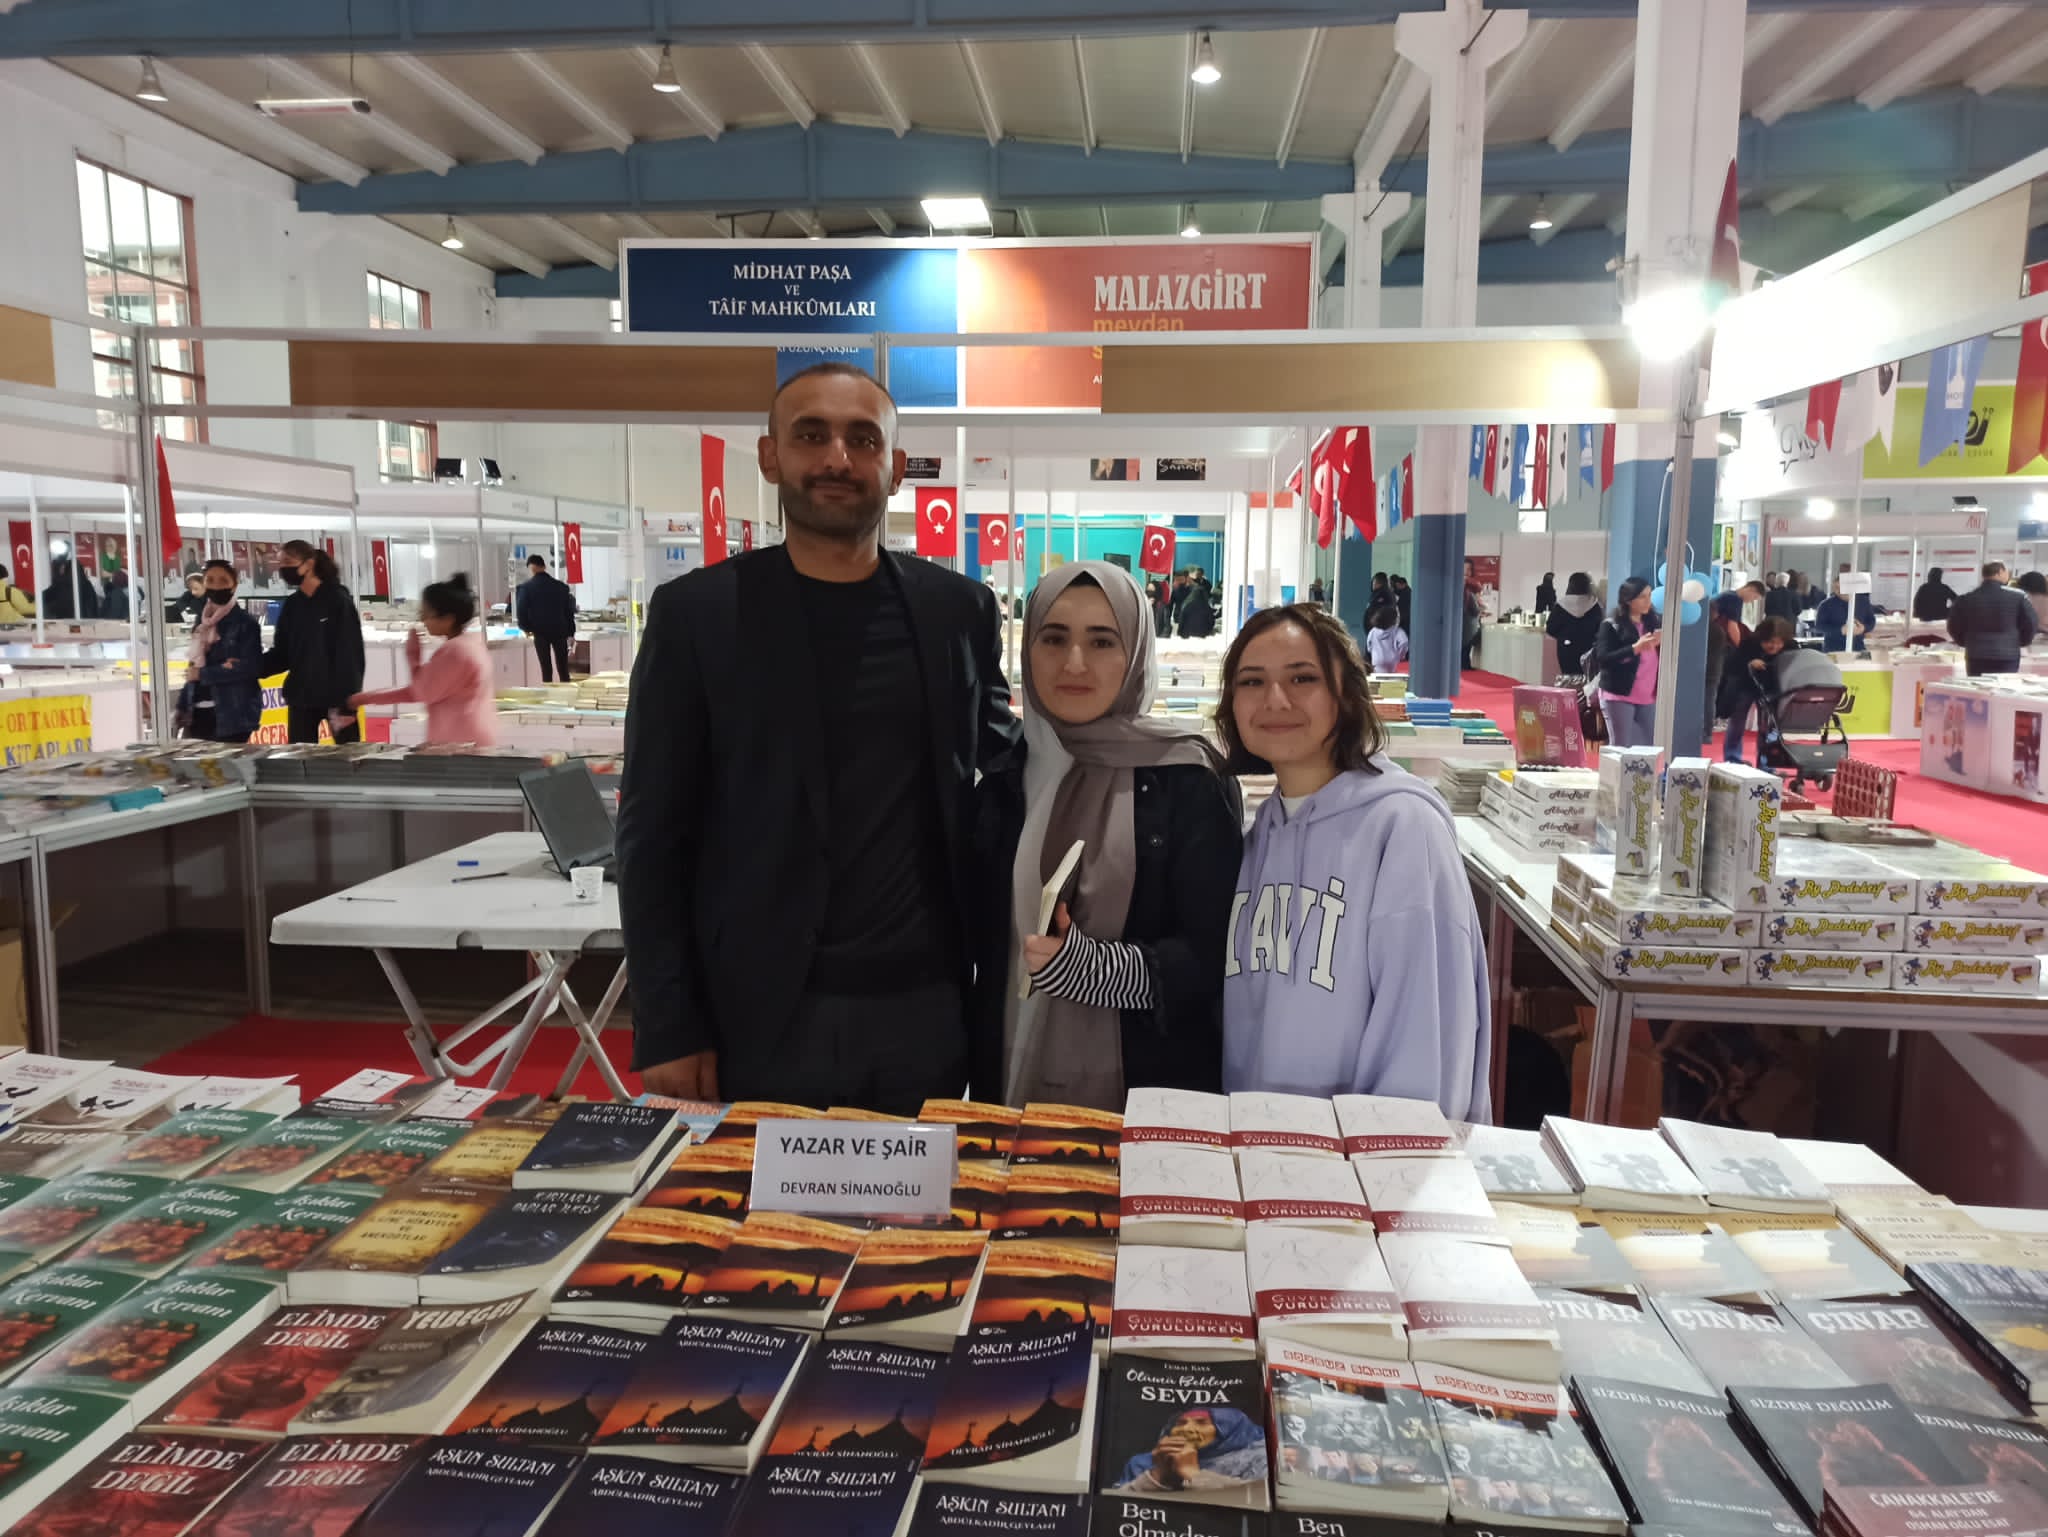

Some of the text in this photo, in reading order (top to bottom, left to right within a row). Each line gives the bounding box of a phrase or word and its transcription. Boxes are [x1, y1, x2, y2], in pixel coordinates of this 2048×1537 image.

[733, 262, 852, 283] MİDHAT PAŞA
[784, 285, 800, 296] VE
[1094, 268, 1267, 312] MALAZGİRT
[708, 297, 876, 317] TÂİF MAHKÛMLARI
[6, 707, 91, 733] ORTAOKUL
[780, 1136, 928, 1161] YAZAR VE ŞAİR
[780, 1180, 922, 1197] DEVRAN SİNANOĞLU
[1273, 1299, 1391, 1312] VURULURKEN
[274, 1309, 387, 1331] ELİMDE
[1128, 1323, 1244, 1335] VURULURKEN
[1671, 1308, 1785, 1334] ÇINAR
[1807, 1308, 1929, 1334] ÇINAR
[263, 1328, 351, 1350] DEĞİL
[538, 1330, 648, 1353] AŞKIN SULTANI
[676, 1325, 786, 1349] AŞKIN SULTANI
[967, 1331, 1077, 1356] AŞKIN SULTANI
[827, 1348, 937, 1371] AŞKIN SULTANI
[1140, 1385, 1231, 1404] SEVDA
[1815, 1397, 1894, 1412] DEĞİLİM
[0, 1422, 71, 1443] ervanı
[1913, 1413, 1972, 1432] İZDEN
[111, 1440, 246, 1472] ELİMDE
[278, 1439, 410, 1464] ELİMDE
[429, 1448, 556, 1477] AŞKIN SULTANI
[91, 1465, 202, 1497] DEĞİL
[263, 1463, 369, 1489] DEĞİL
[592, 1466, 720, 1498] AŞKIN SULTANI
[767, 1466, 897, 1486] AŞKIN SULTANI
[936, 1495, 1067, 1518] AŞKIN SULTANI
[1869, 1489, 2004, 1508] ÇANAKKALE'DE
[1122, 1503, 1166, 1524] Ben
[1299, 1518, 1344, 1537] Ben
